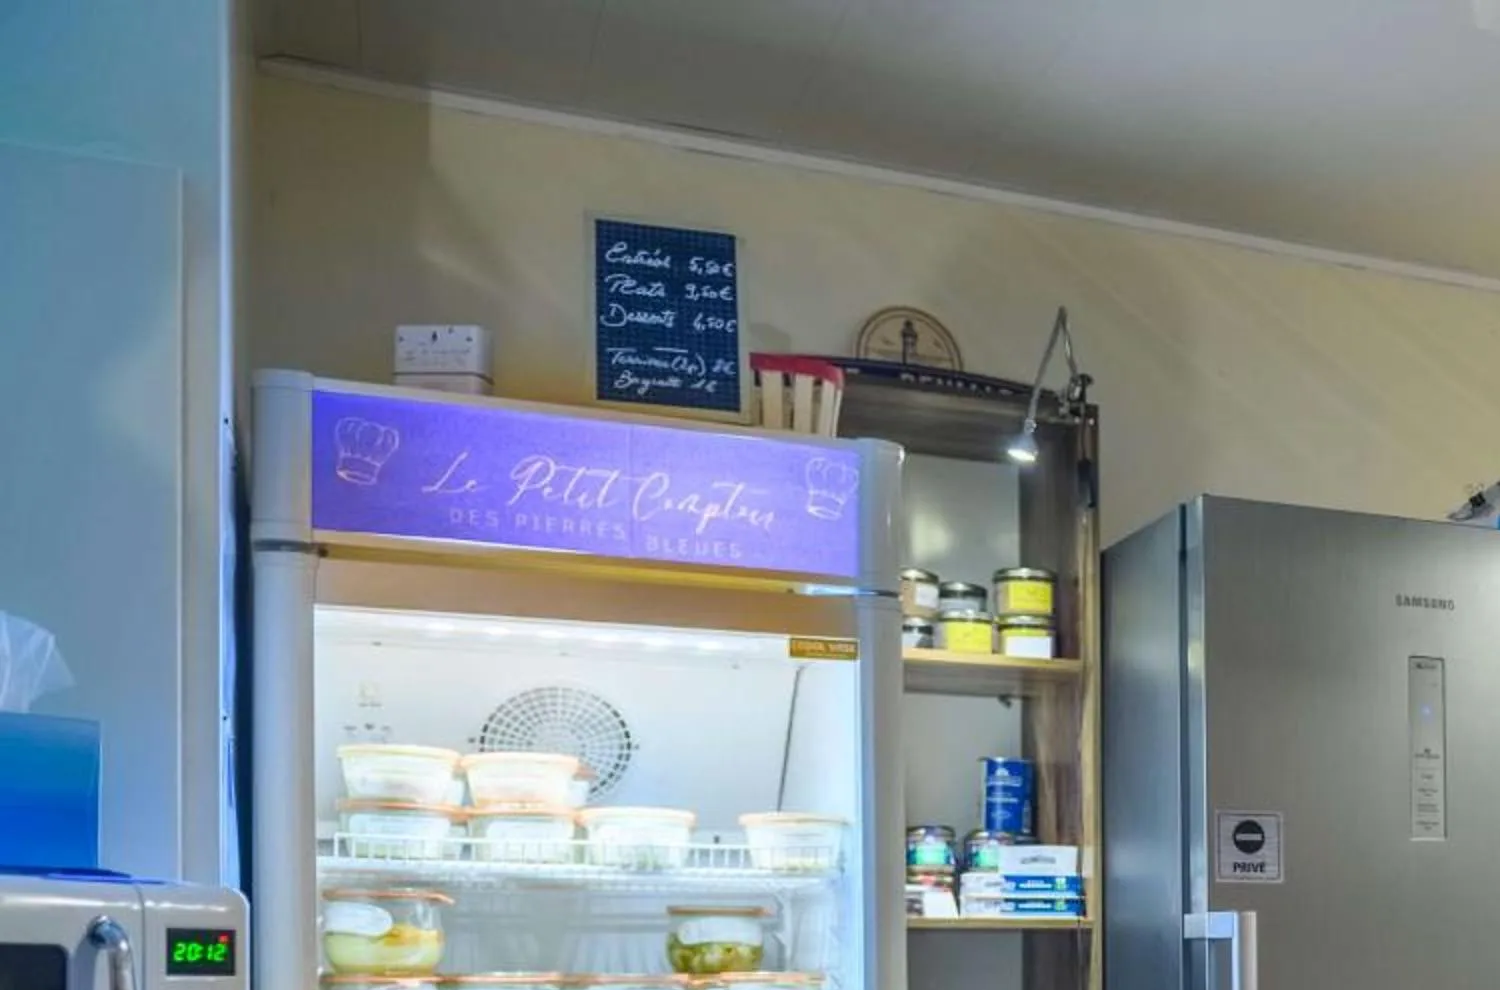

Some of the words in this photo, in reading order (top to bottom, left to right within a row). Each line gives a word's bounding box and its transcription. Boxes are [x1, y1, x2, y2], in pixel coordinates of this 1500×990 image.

[422, 451, 488, 494] Le
[507, 454, 621, 509] Petit
[451, 509, 500, 528] DES
[515, 513, 626, 541] PIERRES
[646, 535, 742, 560] BLEUES
[1395, 594, 1455, 611] SAMSUNG
